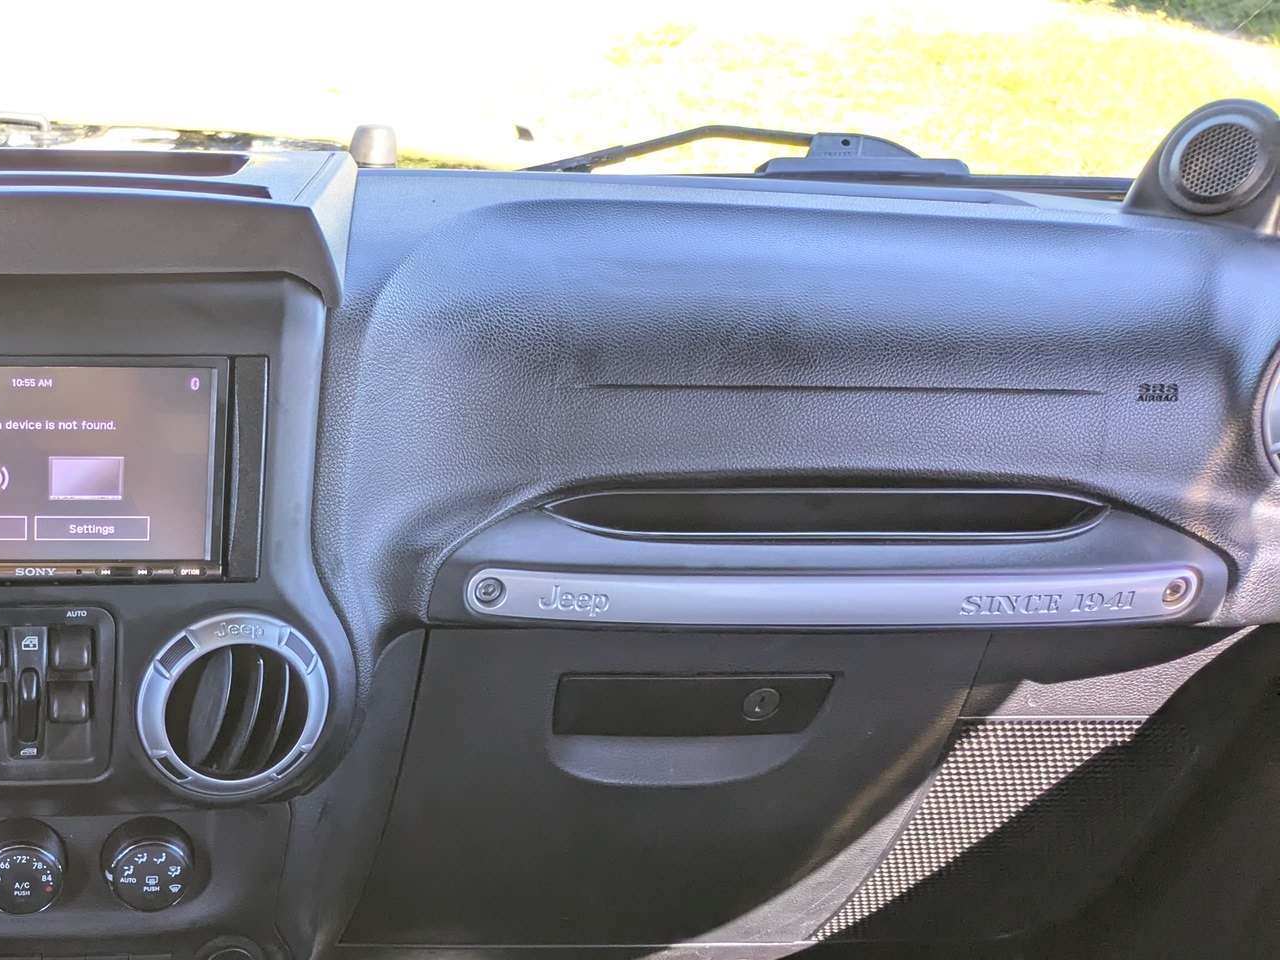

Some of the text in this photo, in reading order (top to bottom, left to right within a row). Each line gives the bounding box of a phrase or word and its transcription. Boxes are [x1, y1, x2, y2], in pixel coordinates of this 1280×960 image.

[11, 378, 53, 388] 10:55 AM
[5, 419, 42, 430] device
[45, 419, 55, 430] is
[58, 420, 78, 430] not
[81, 419, 117, 430] found.
[69, 524, 116, 536] Settings
[15, 567, 57, 577] SONY
[538, 584, 610, 617] Jeep
[958, 590, 1137, 616] SINCE 1941
[16, 855, 27, 864] 72
[0, 861, 10, 869] 66
[32, 862, 43, 870] 78
[14, 882, 30, 890] A/C
